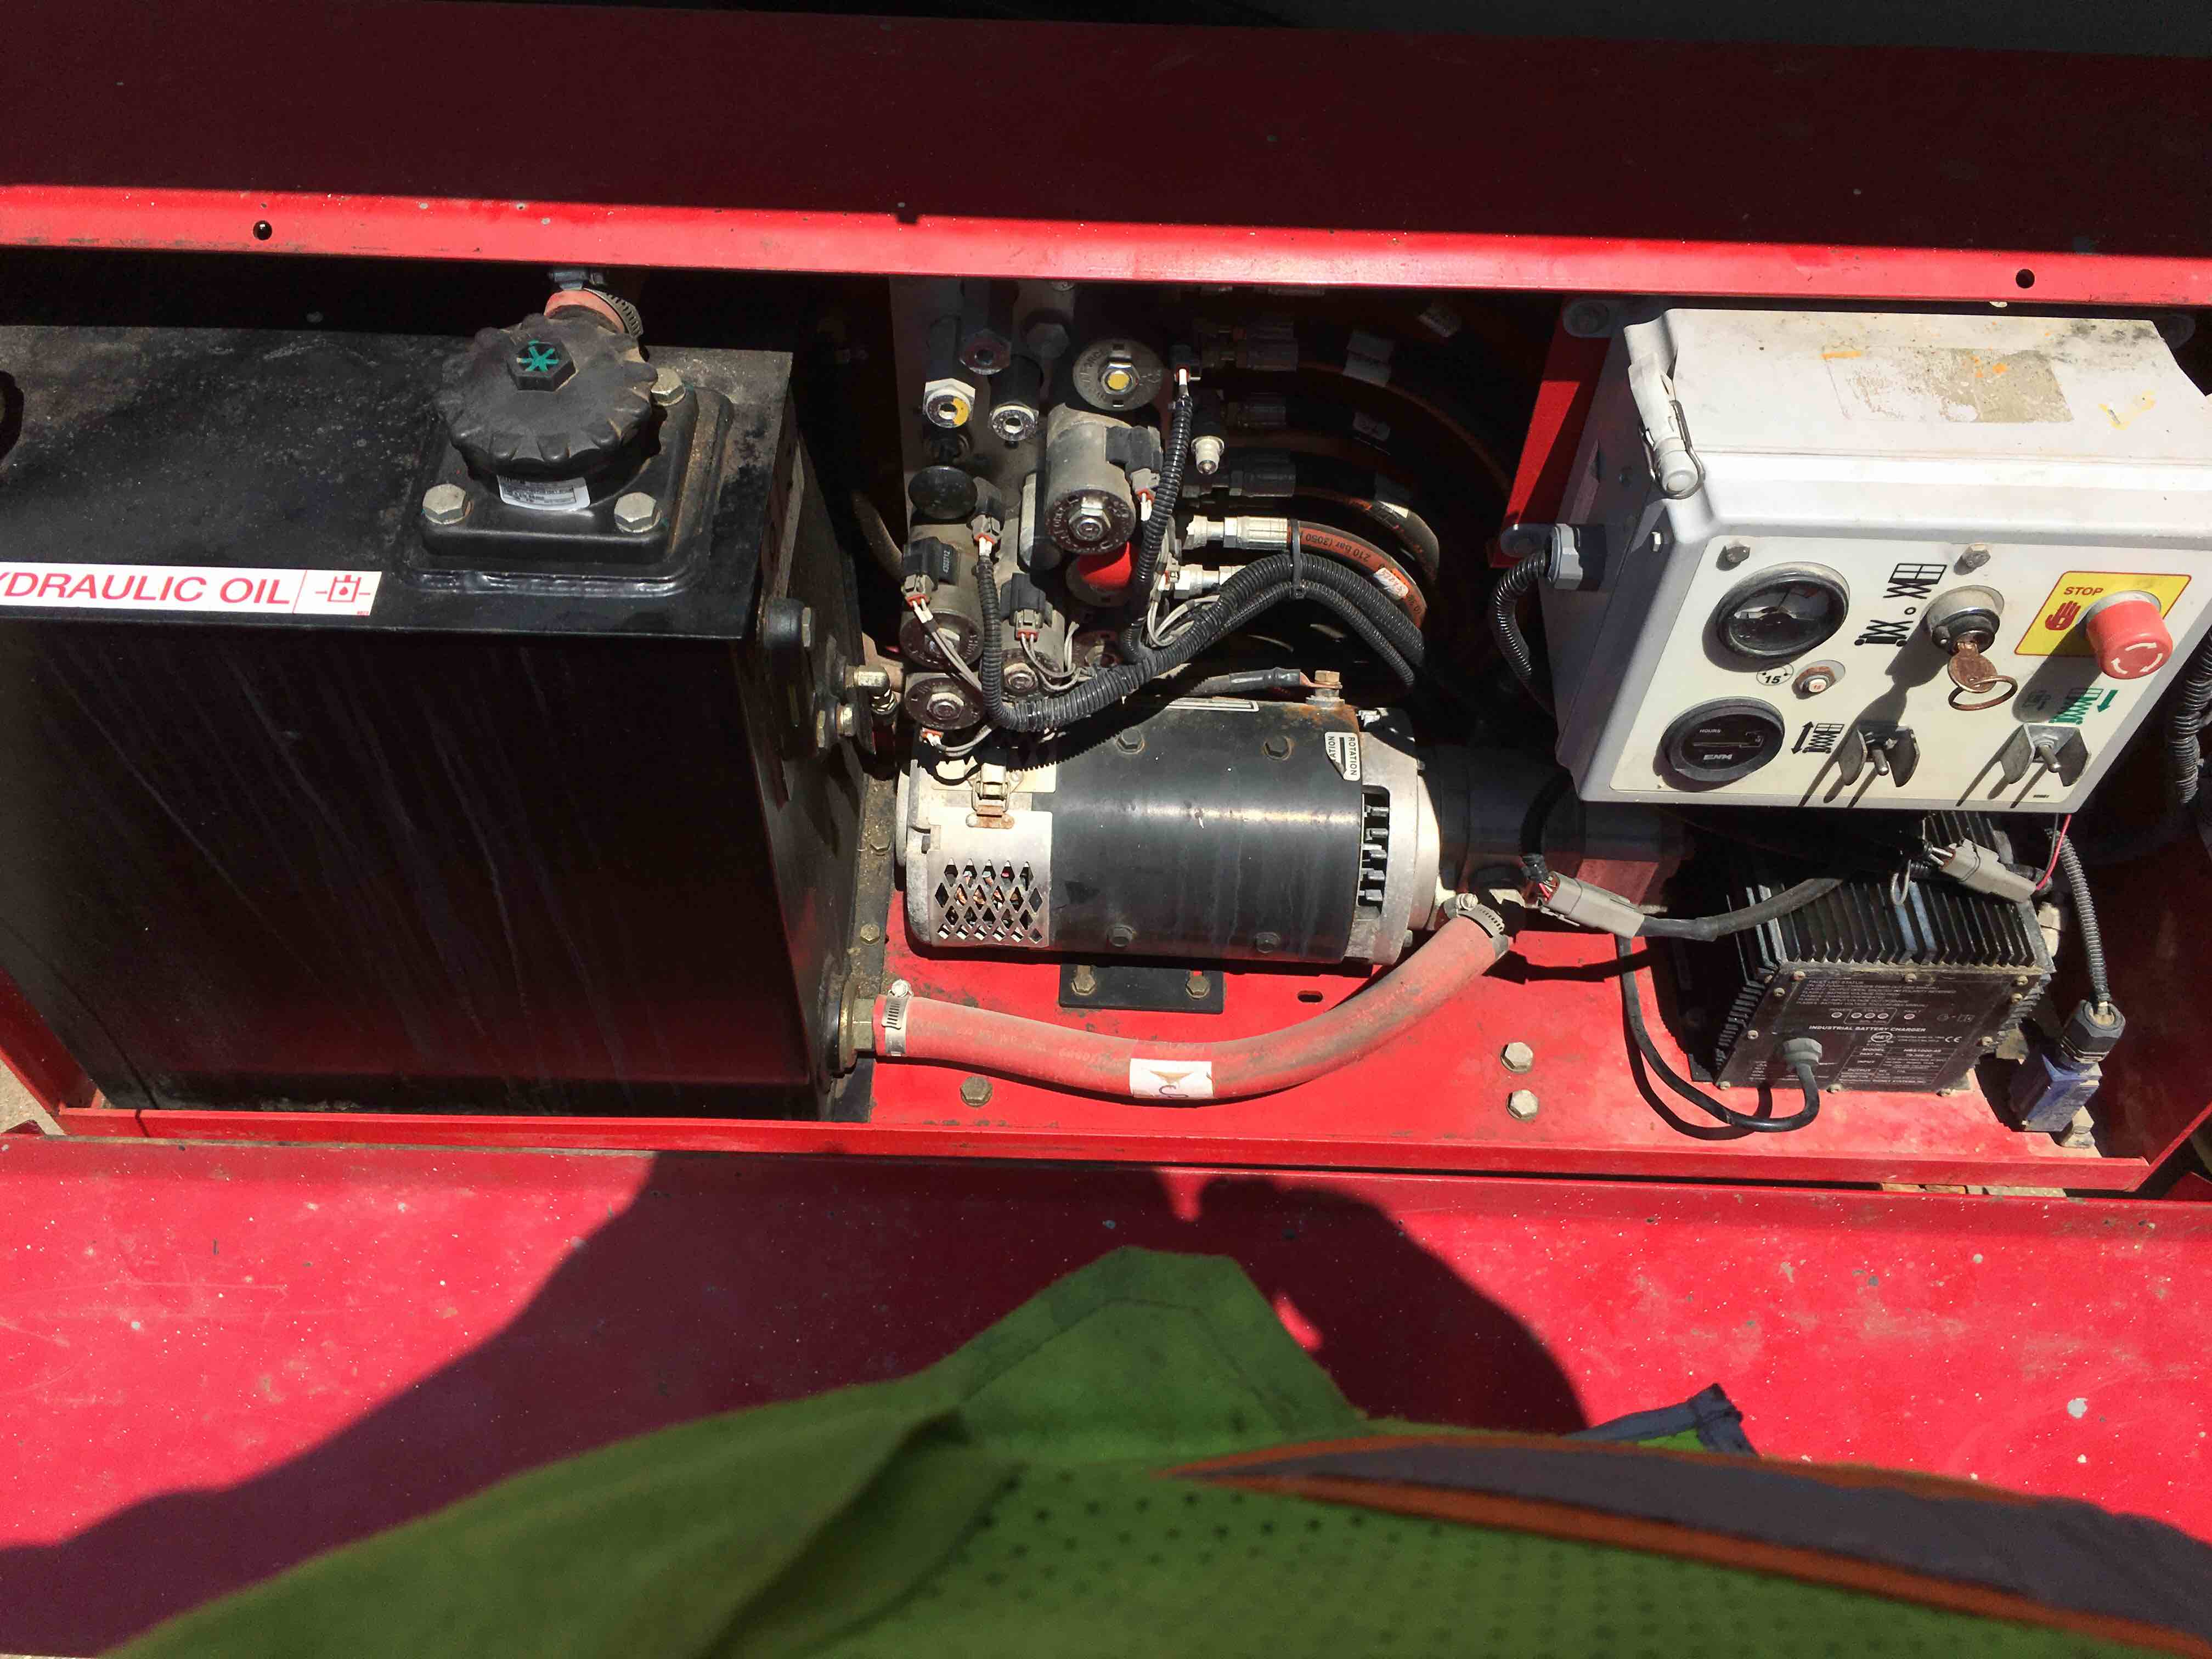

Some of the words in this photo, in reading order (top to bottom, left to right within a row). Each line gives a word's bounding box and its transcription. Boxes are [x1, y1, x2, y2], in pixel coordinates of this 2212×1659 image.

[1306, 532, 1334, 547] (3050
[1335, 541, 1352, 554] bar
[1352, 548, 1370, 562] 210
[0, 572, 207, 602] DRAULIC
[220, 578, 290, 603] OIL
[2063, 586, 2104, 596] STOP
[1764, 675, 1781, 684] 15
[1348, 737, 1358, 776] ROTATION
